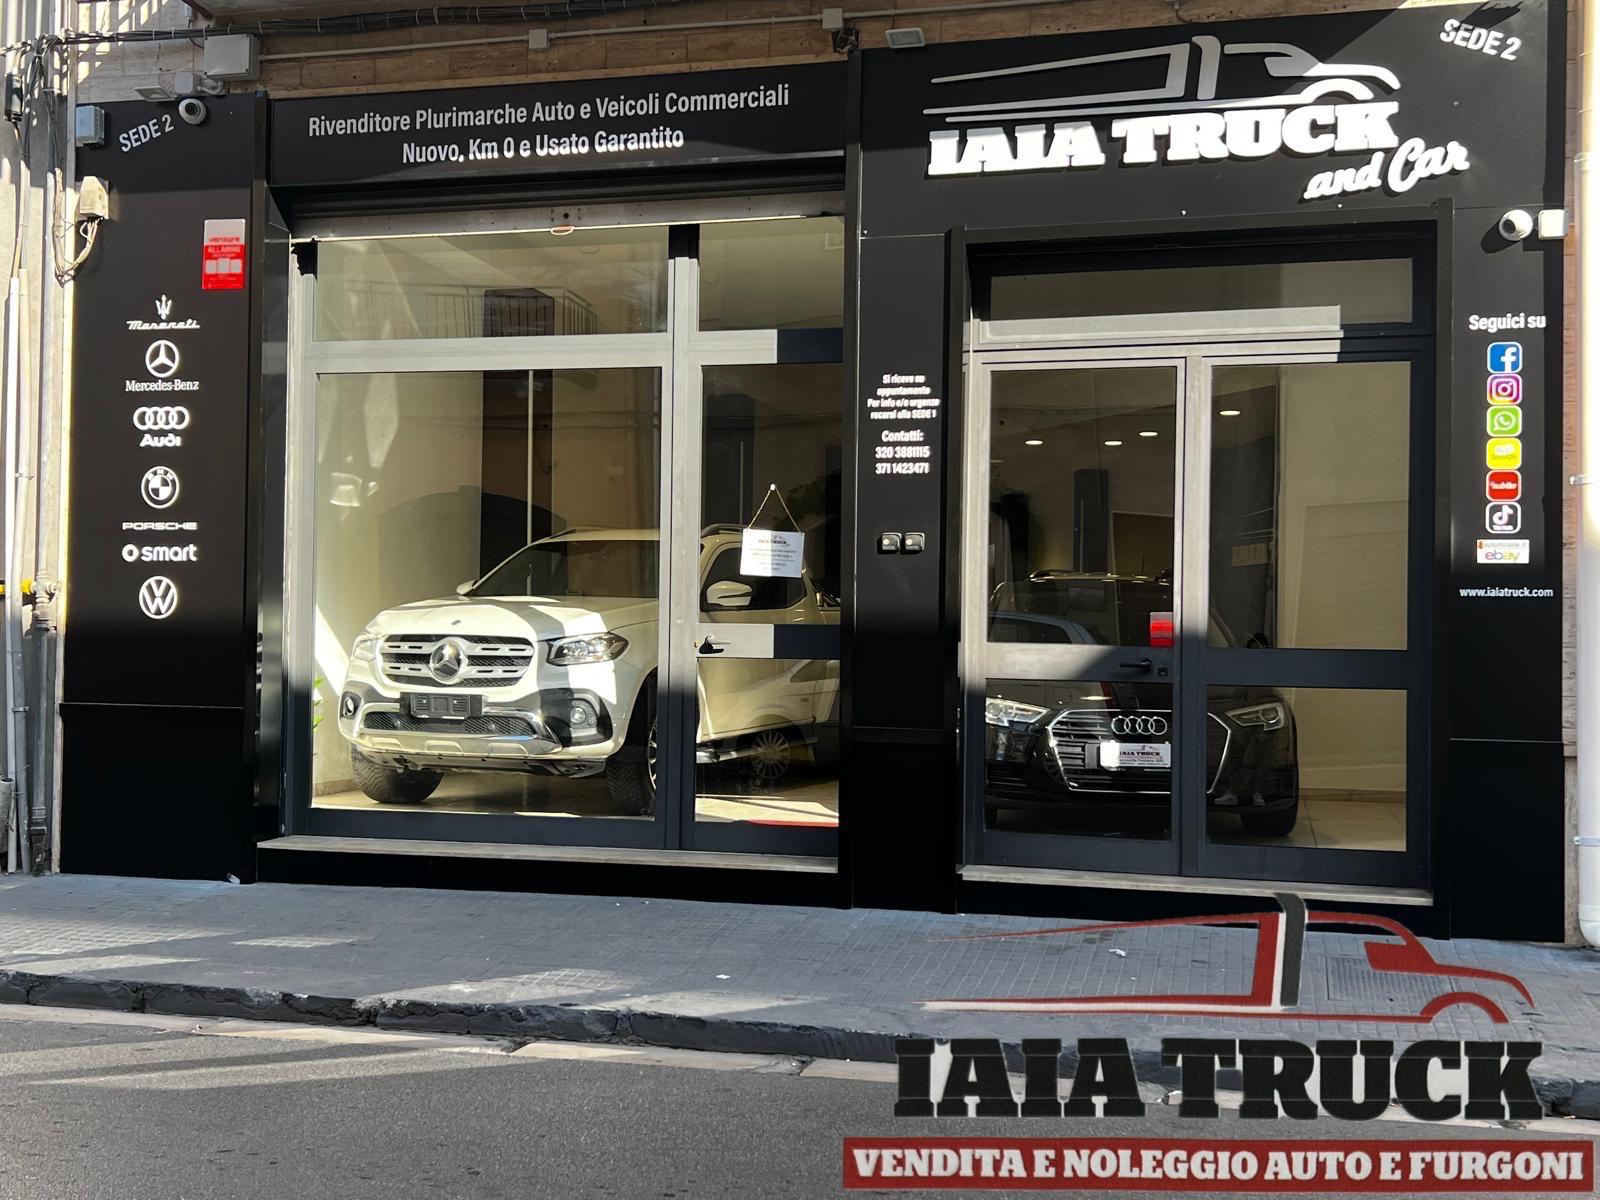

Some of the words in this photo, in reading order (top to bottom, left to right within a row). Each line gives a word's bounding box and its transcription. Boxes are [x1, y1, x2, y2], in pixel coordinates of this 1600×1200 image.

[1439, 18, 1504, 55] SEDE
[1499, 36, 1522, 60] 2
[308, 113, 411, 136] Rivenditore
[415, 102, 527, 129] Plurimarche
[531, 101, 575, 122] Auto
[579, 102, 591, 119] e
[596, 93, 659, 118] Veicoli
[665, 83, 789, 113] Commerciali
[119, 119, 161, 152] SEDE
[161, 114, 175, 132] 2
[927, 121, 1105, 176] IAIA
[1111, 101, 1400, 163] TRUCK
[402, 142, 464, 164] Nuovo,
[468, 138, 499, 160] Km
[519, 139, 531, 157] e
[535, 132, 589, 157] Usato
[594, 126, 684, 152] Garantito
[1303, 152, 1385, 199] and
[1387, 137, 1470, 193] Car
[126, 318, 201, 331] Maserati
[1468, 312, 1525, 333] Seguici
[1527, 315, 1547, 329] su
[125, 379, 199, 392] Mercedes-Benz
[891, 374, 914, 383] riceve
[876, 387, 931, 397] appuntamento
[867, 398, 880, 408] Per
[880, 397, 895, 408] info
[870, 410, 897, 420] recarsi
[911, 409, 931, 419] SEDE
[931, 409, 937, 418] 1
[139, 433, 182, 447] Audi
[881, 429, 925, 443] Contatti:
[875, 446, 894, 459] 320
[894, 445, 931, 458] 3881115
[875, 462, 891, 475] 371
[892, 462, 930, 474] 1423471
[122, 521, 198, 531] PORSCHE
[140, 543, 198, 562] smart
[1484, 549, 1520, 562] ebay
[1459, 586, 1554, 598] www.iaiatruck.com
